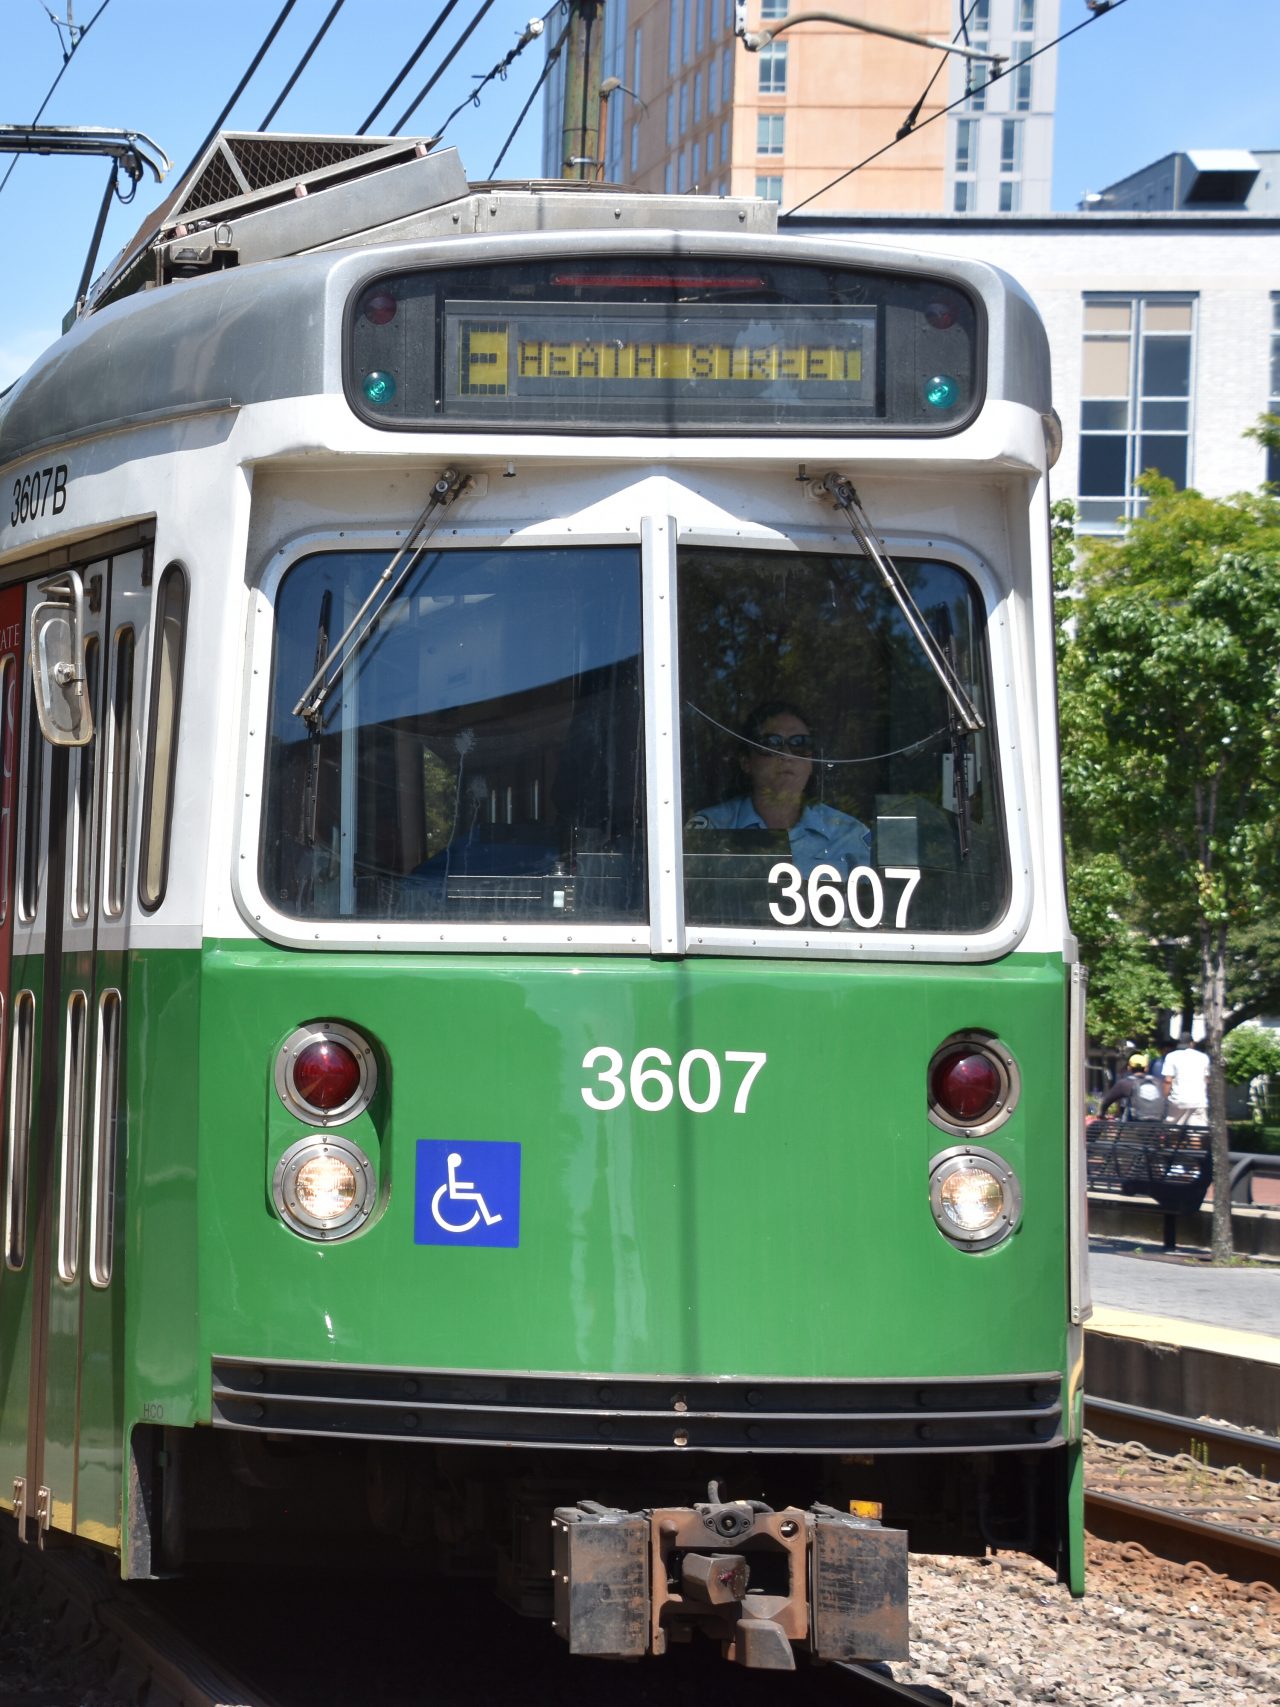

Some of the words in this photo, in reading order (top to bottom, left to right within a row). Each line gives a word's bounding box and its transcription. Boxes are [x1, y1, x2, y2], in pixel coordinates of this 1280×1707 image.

[460, 320, 508, 396] E
[521, 342, 657, 377] HEATH
[691, 345, 859, 380] STREET
[11, 464, 68, 528] 3607B
[767, 862, 921, 929] 3607
[581, 1046, 767, 1114] 3607
